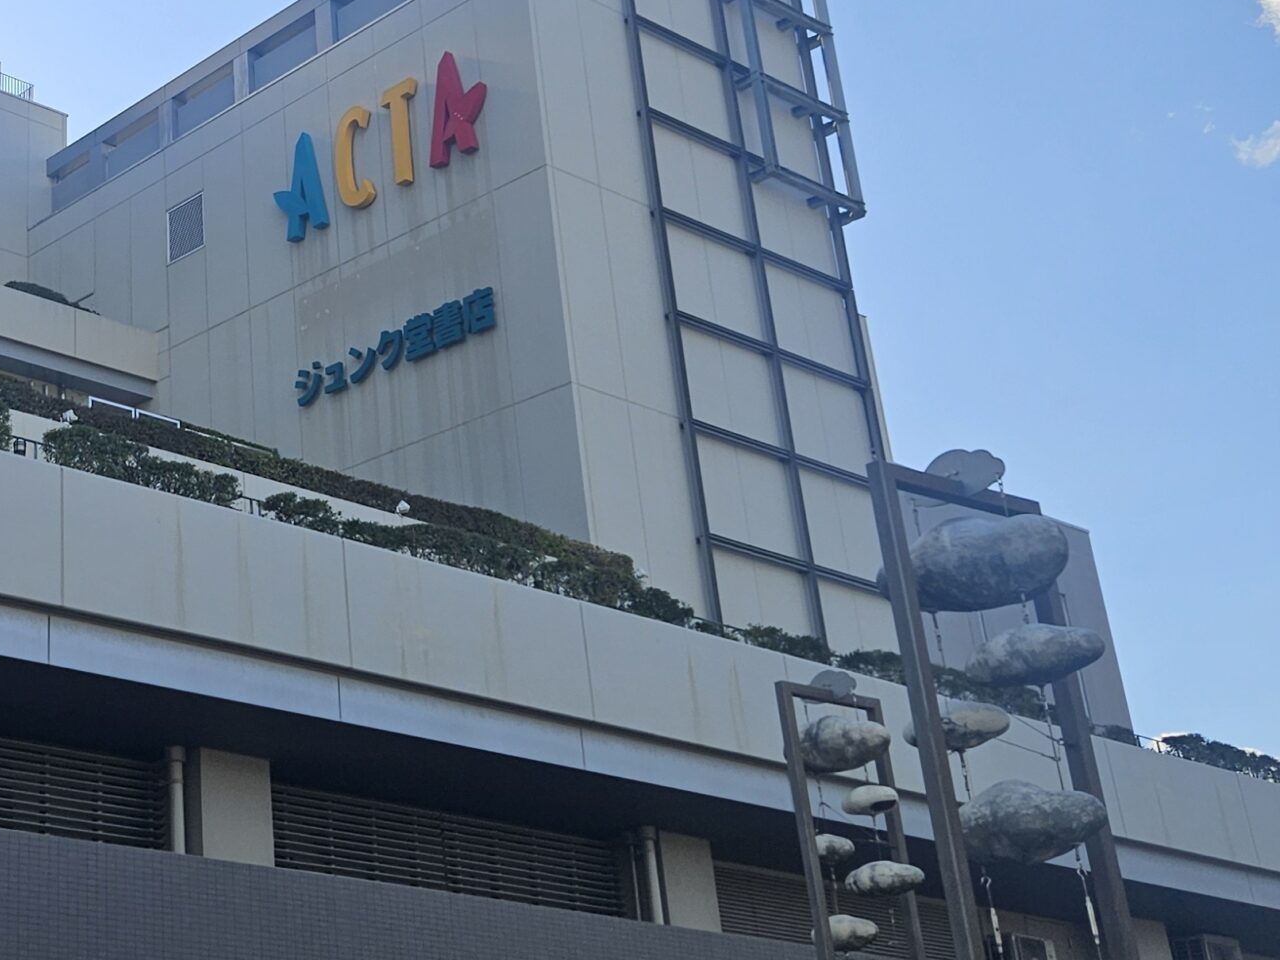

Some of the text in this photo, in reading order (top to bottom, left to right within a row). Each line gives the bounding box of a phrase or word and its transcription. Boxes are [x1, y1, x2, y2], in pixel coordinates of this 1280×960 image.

[273, 51, 487, 242] ACTA
[294, 286, 497, 407] ジュンク堂書店
